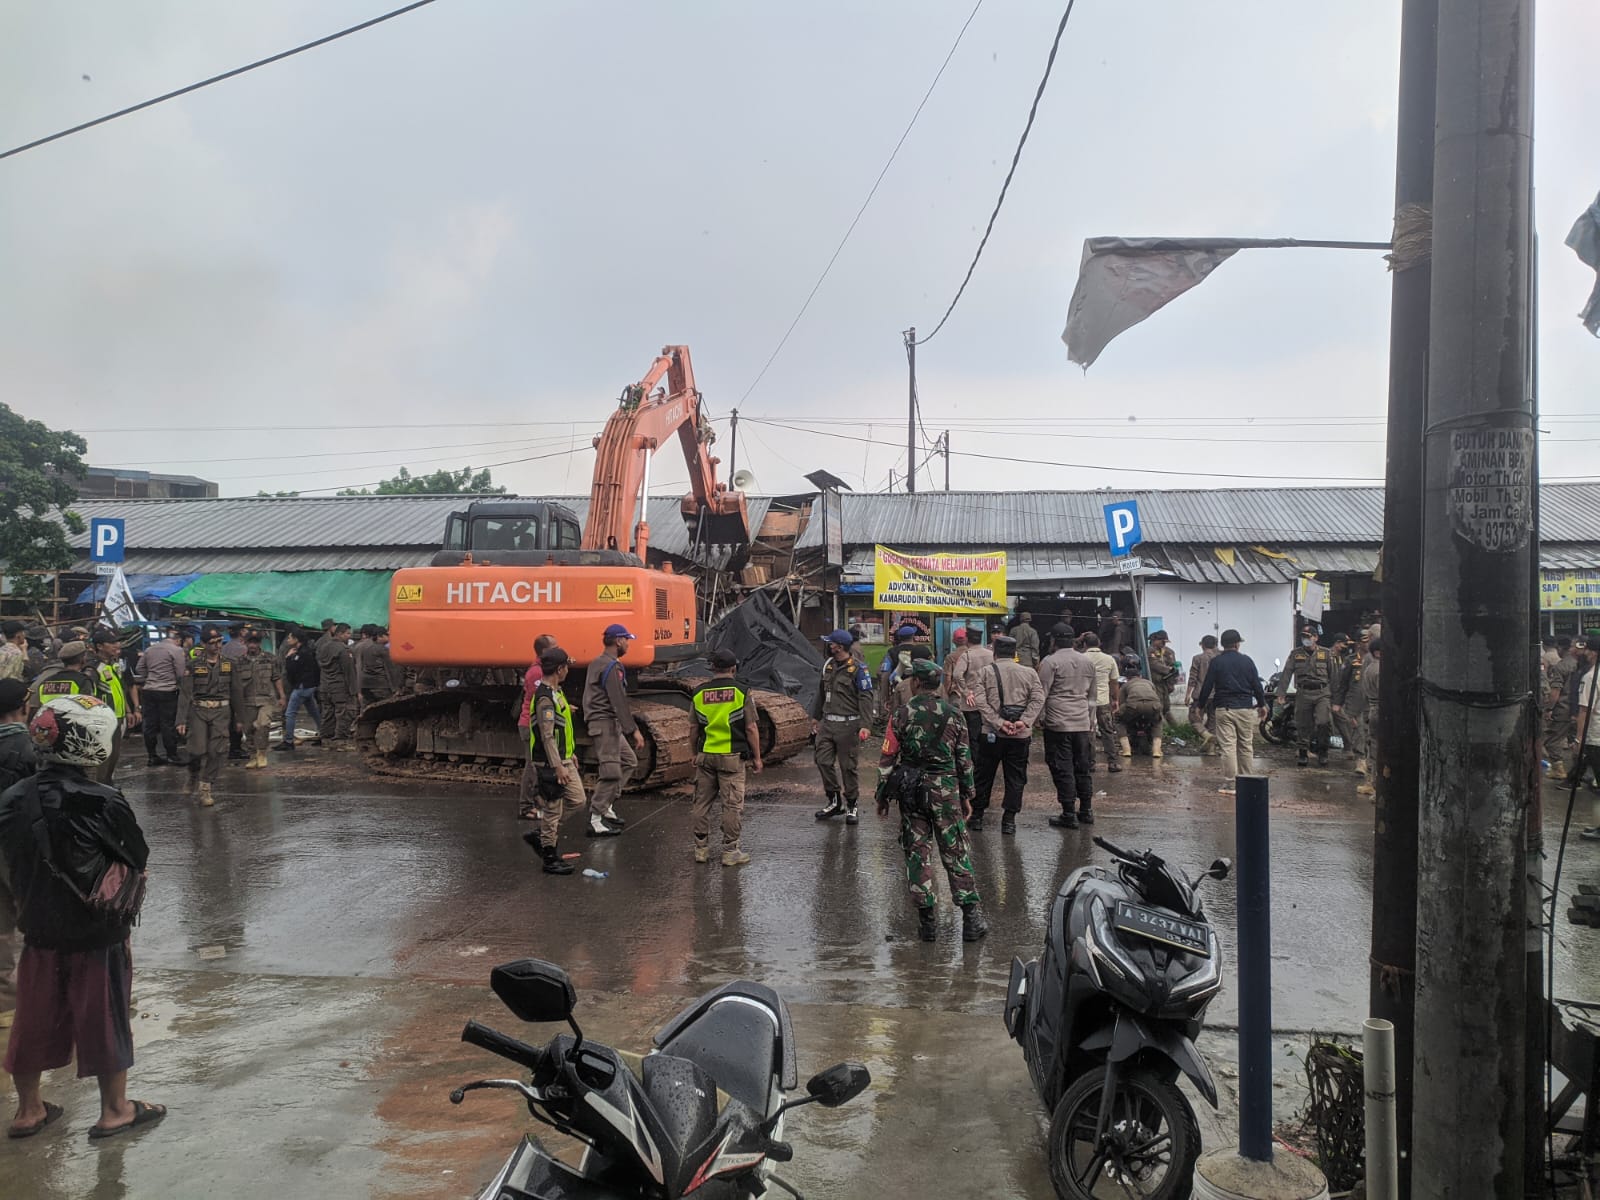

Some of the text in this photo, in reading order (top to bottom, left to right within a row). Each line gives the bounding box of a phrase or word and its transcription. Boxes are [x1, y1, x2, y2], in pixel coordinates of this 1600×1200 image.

[1455, 431, 1495, 450] BUTUH
[1494, 470, 1510, 485] Th
[1455, 488, 1488, 503] Mobil
[1496, 488, 1510, 503] Th
[1470, 505, 1500, 520] Jam
[1112, 508, 1134, 548] P
[96, 524, 118, 557] P
[941, 558, 972, 571] MELAWAN
[975, 558, 999, 571] HUKUM
[447, 581, 561, 604] HITACHI
[888, 582, 919, 592] ADVOKAT
[967, 589, 992, 599] HUKUM
[1542, 583, 1560, 592] SAPI
[879, 593, 923, 604] KAMARUDDIN
[44, 683, 70, 693] POL-PP
[704, 689, 734, 702] POL-PP
[1124, 908, 1133, 919] A
